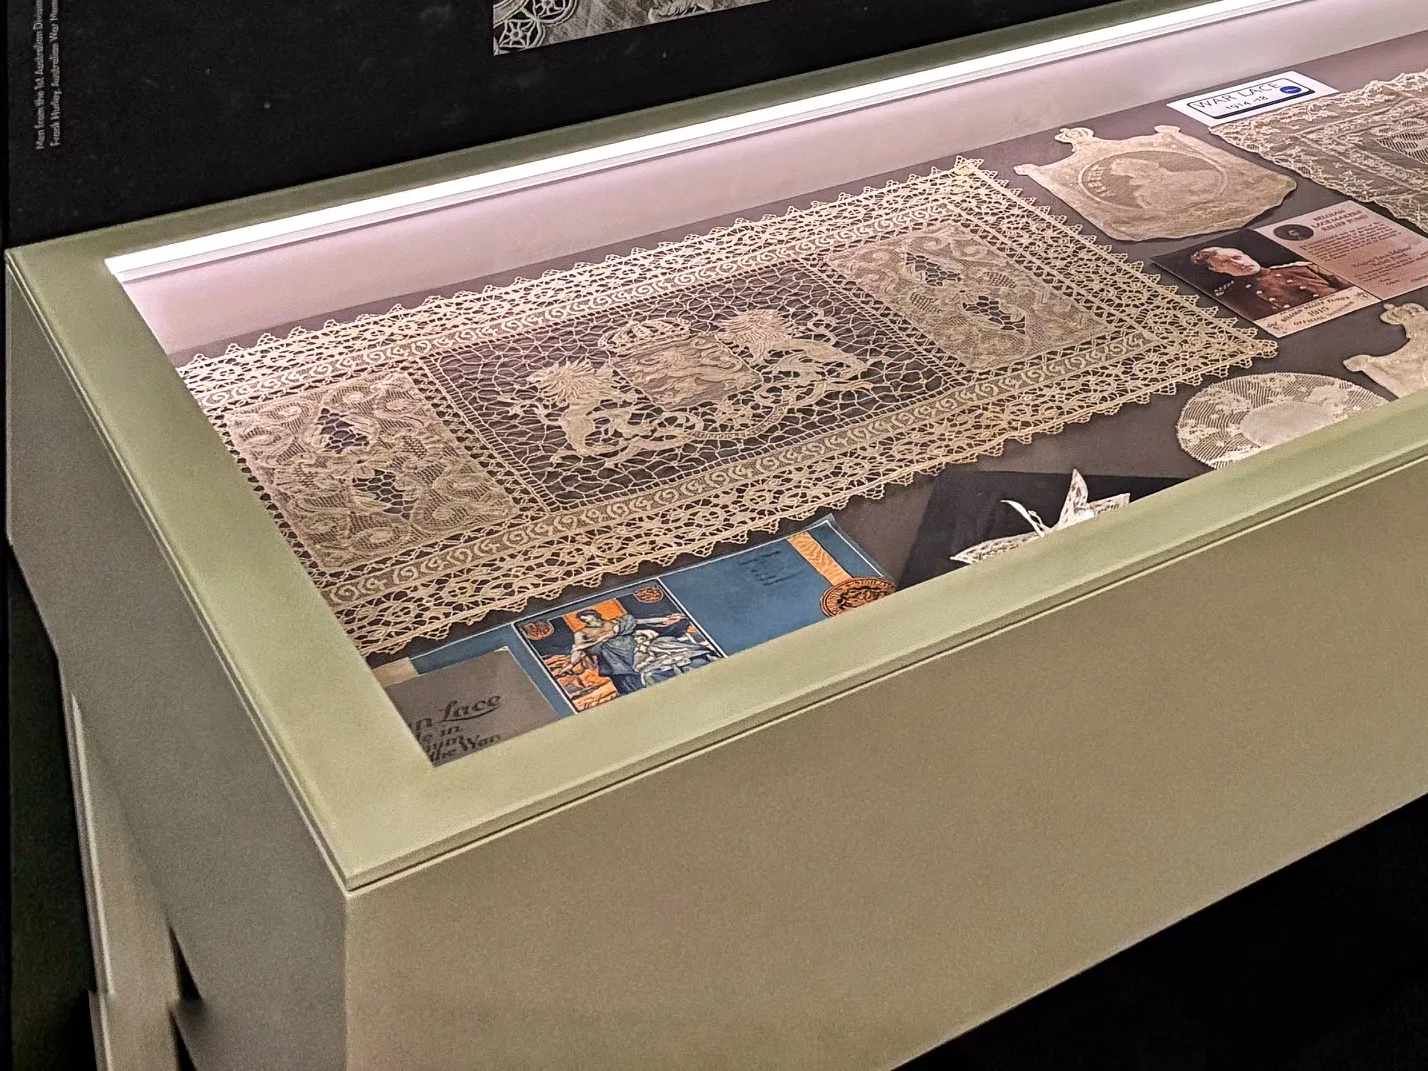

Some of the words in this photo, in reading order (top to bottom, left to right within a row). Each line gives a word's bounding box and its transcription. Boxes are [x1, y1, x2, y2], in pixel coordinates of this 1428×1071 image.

[33, 30, 45, 75] Australian
[49, 42, 60, 87] Australian
[33, 90, 45, 107] the
[1193, 94, 1237, 109] WAR
[1239, 82, 1282, 98] LACE
[438, 695, 501, 724] Lace
